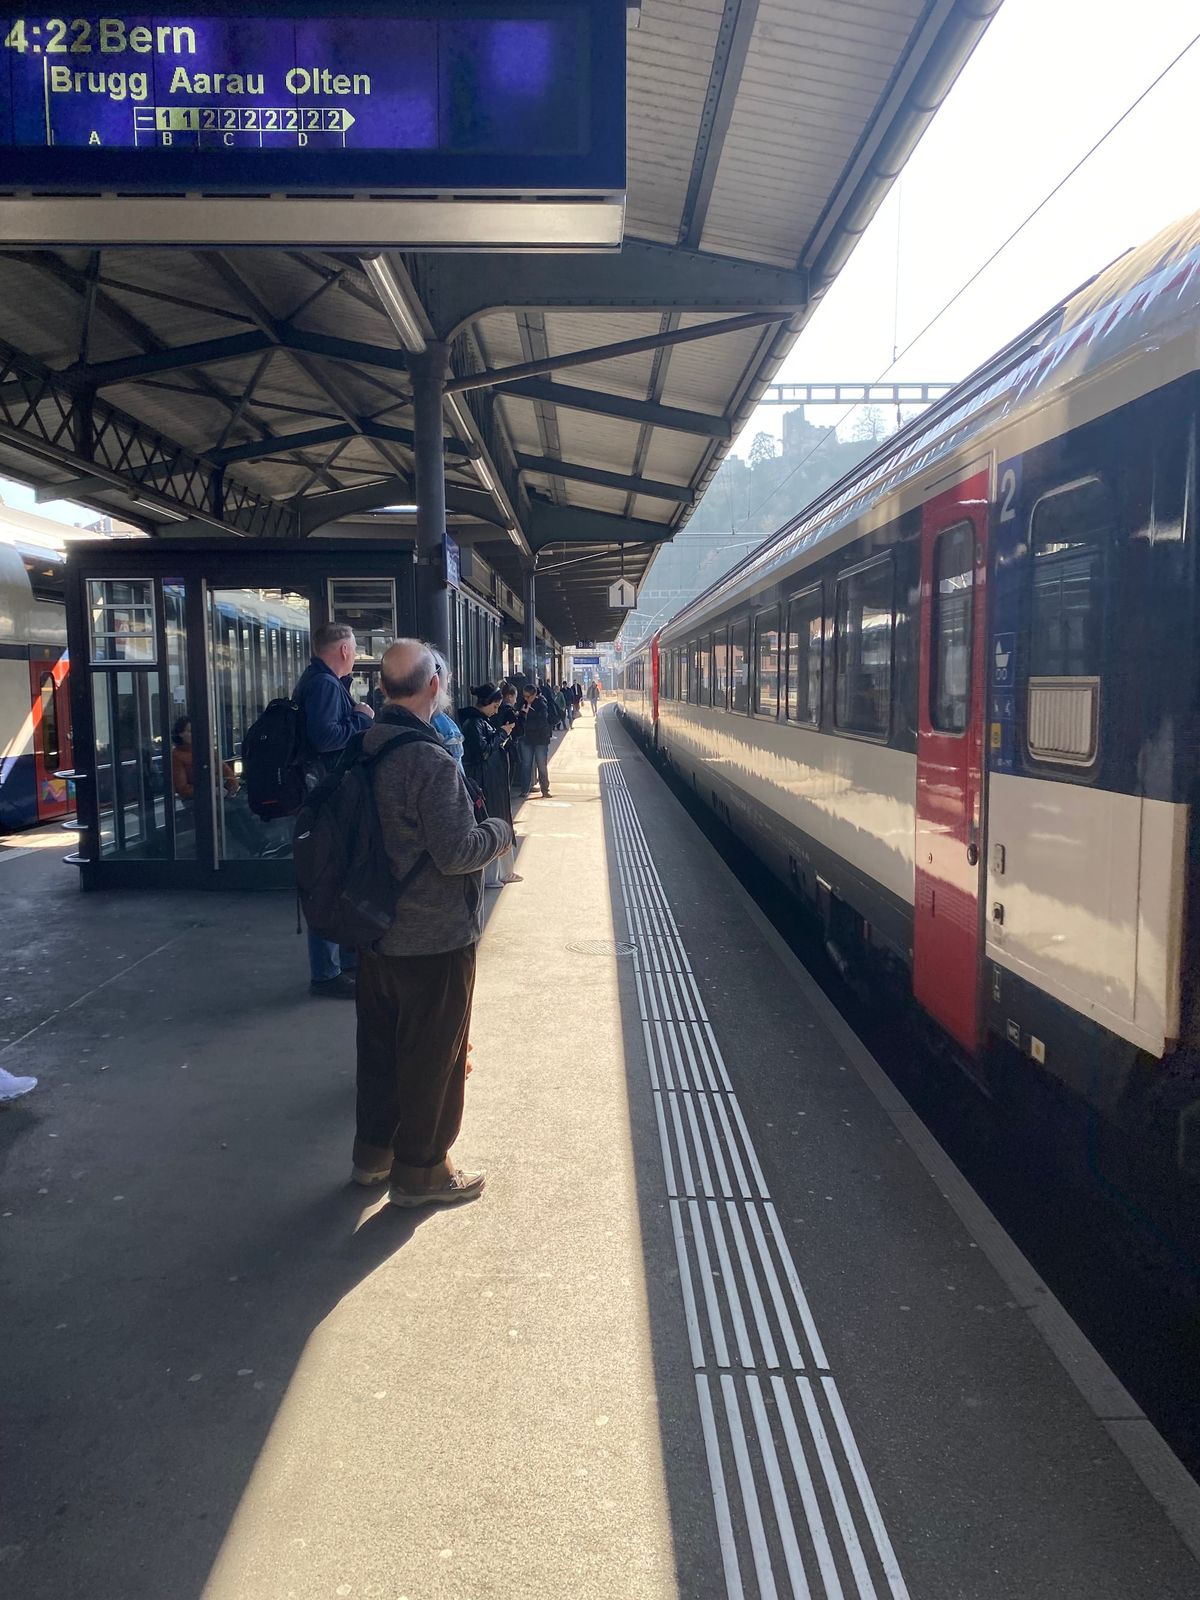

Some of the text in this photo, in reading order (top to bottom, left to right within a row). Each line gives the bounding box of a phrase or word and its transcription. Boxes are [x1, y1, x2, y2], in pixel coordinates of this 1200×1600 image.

[100, 19, 196, 54] Bern
[51, 66, 371, 100] Brugg Aarau Olten
[88, 131, 308, 147] A B C D
[1000, 468, 1016, 524] 2
[618, 584, 624, 605] 1
